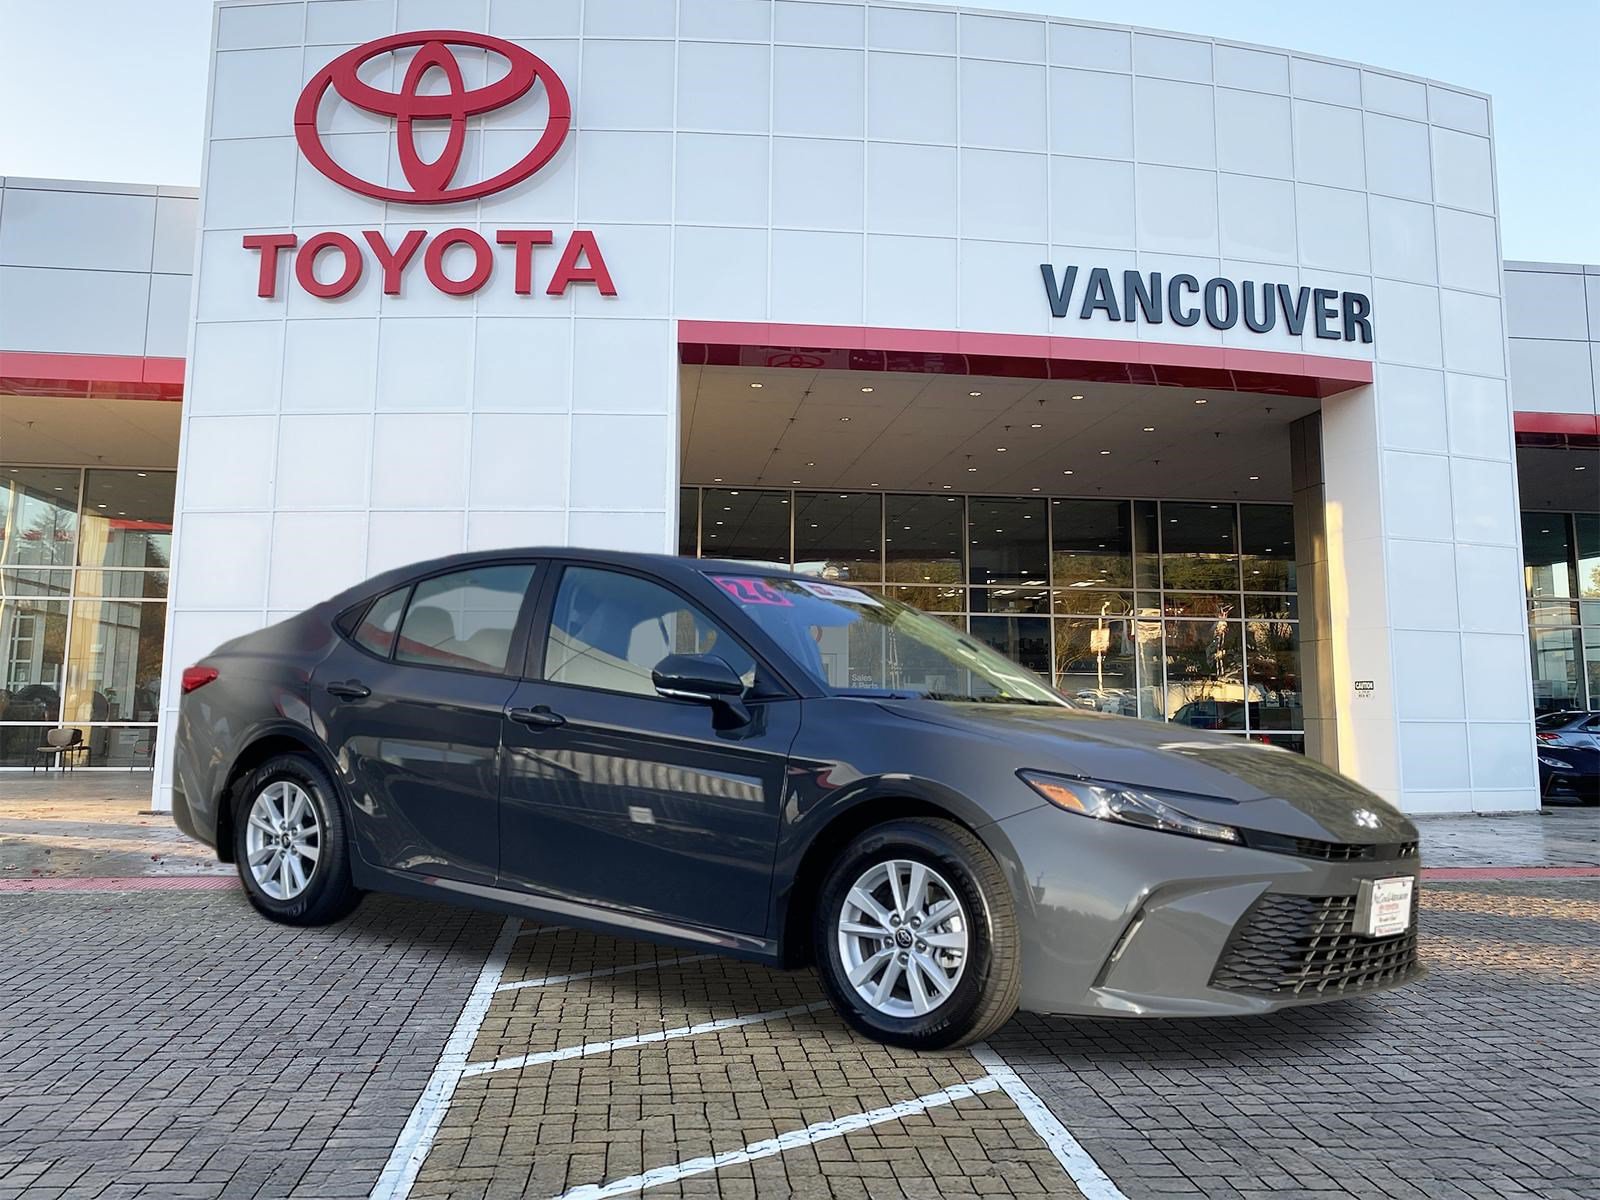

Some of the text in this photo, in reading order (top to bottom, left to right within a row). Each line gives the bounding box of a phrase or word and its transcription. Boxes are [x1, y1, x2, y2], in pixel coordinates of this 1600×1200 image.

[243, 229, 616, 298] TOYOTA
[1040, 264, 1373, 343] VANCOUVER
[718, 576, 782, 603] 26
[851, 673, 873, 682] Sales
